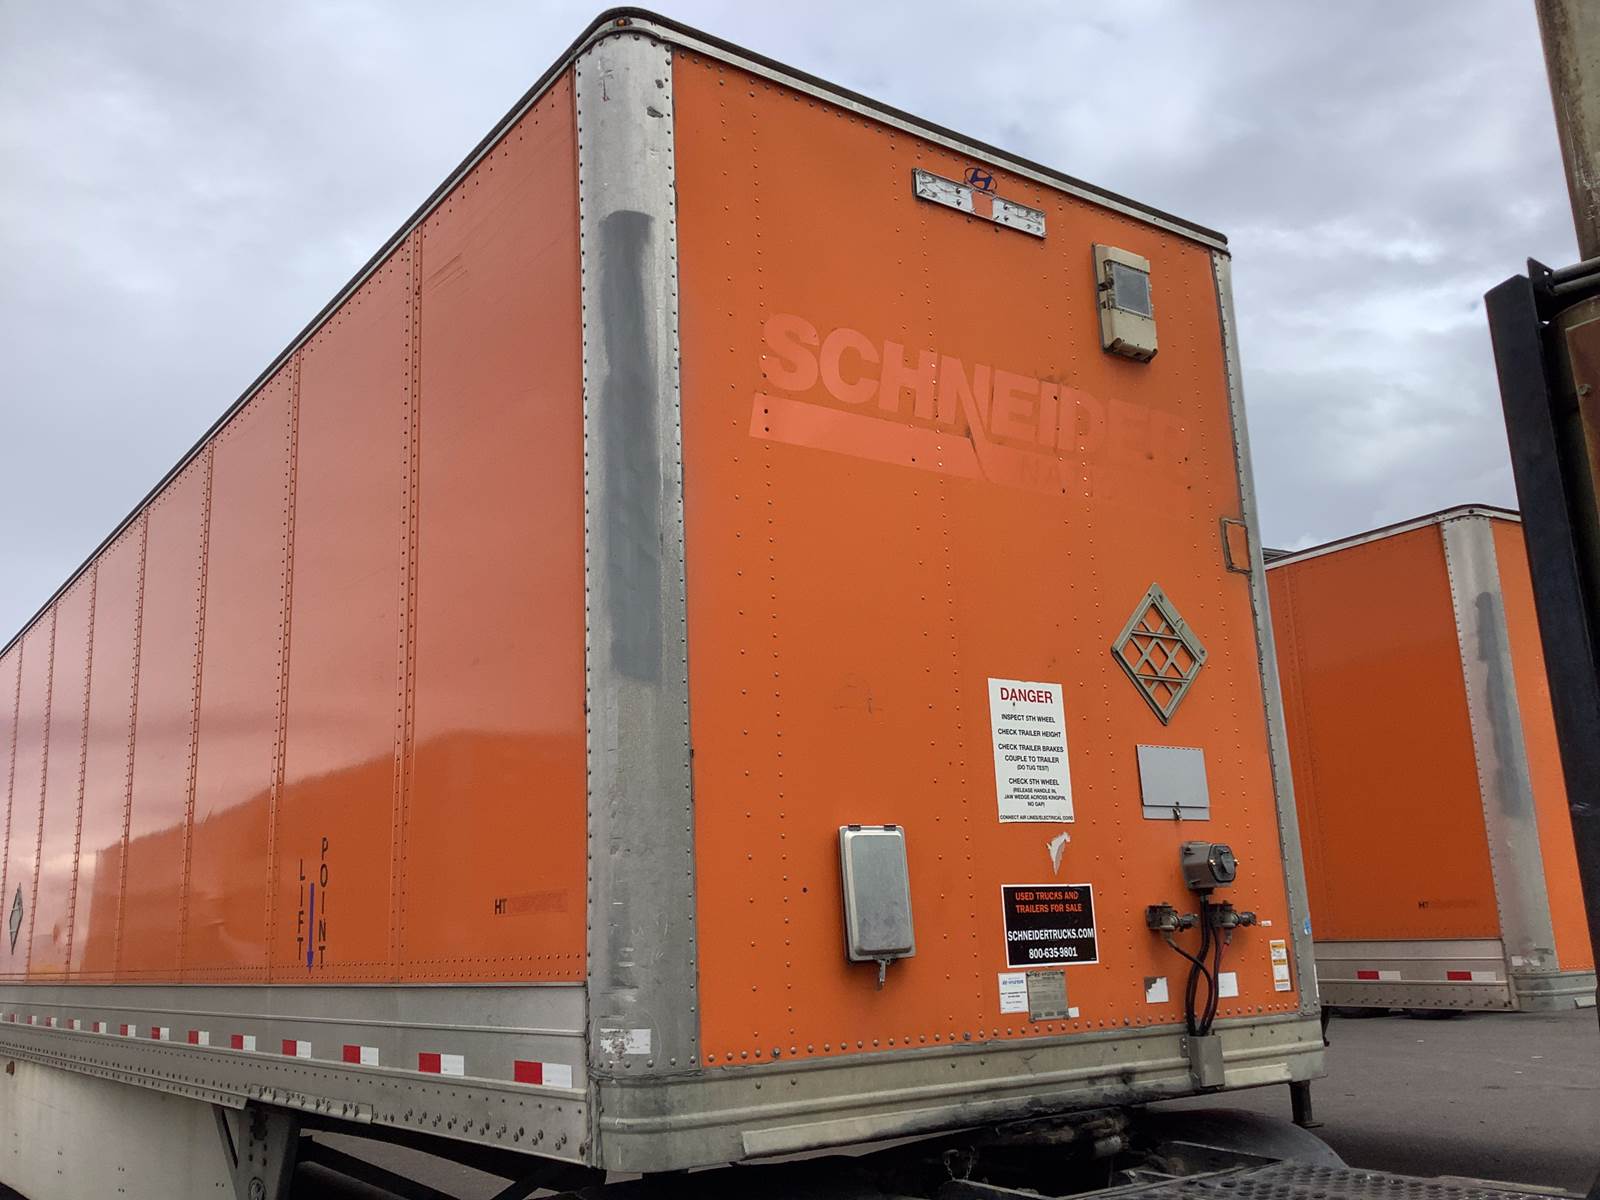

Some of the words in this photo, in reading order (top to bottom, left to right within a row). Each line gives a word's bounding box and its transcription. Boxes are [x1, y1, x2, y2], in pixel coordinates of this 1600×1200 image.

[1000, 687, 1053, 704] DANGER
[1001, 713, 1024, 721] INSPECT
[997, 728, 1017, 736] CHECK
[1018, 729, 1041, 737] TRAILER
[1042, 730, 1061, 738] HEIGHT
[998, 743, 1018, 751] CHECK
[1019, 744, 1041, 752] TRAILER
[1042, 745, 1064, 753] BRAKES
[1036, 756, 1060, 764] TRAILER
[1015, 891, 1034, 901] USED
[1036, 891, 1063, 900] TRUCKS
[1064, 890, 1079, 900] AND
[318, 837, 328, 965] POINT
[297, 858, 305, 961] LIFT
[1015, 904, 1049, 913] TRAILERS
[1050, 904, 1064, 912] FOR
[1065, 903, 1083, 912] SALE
[1007, 927, 1094, 942] SCHNEIDERTRUCKS.COM
